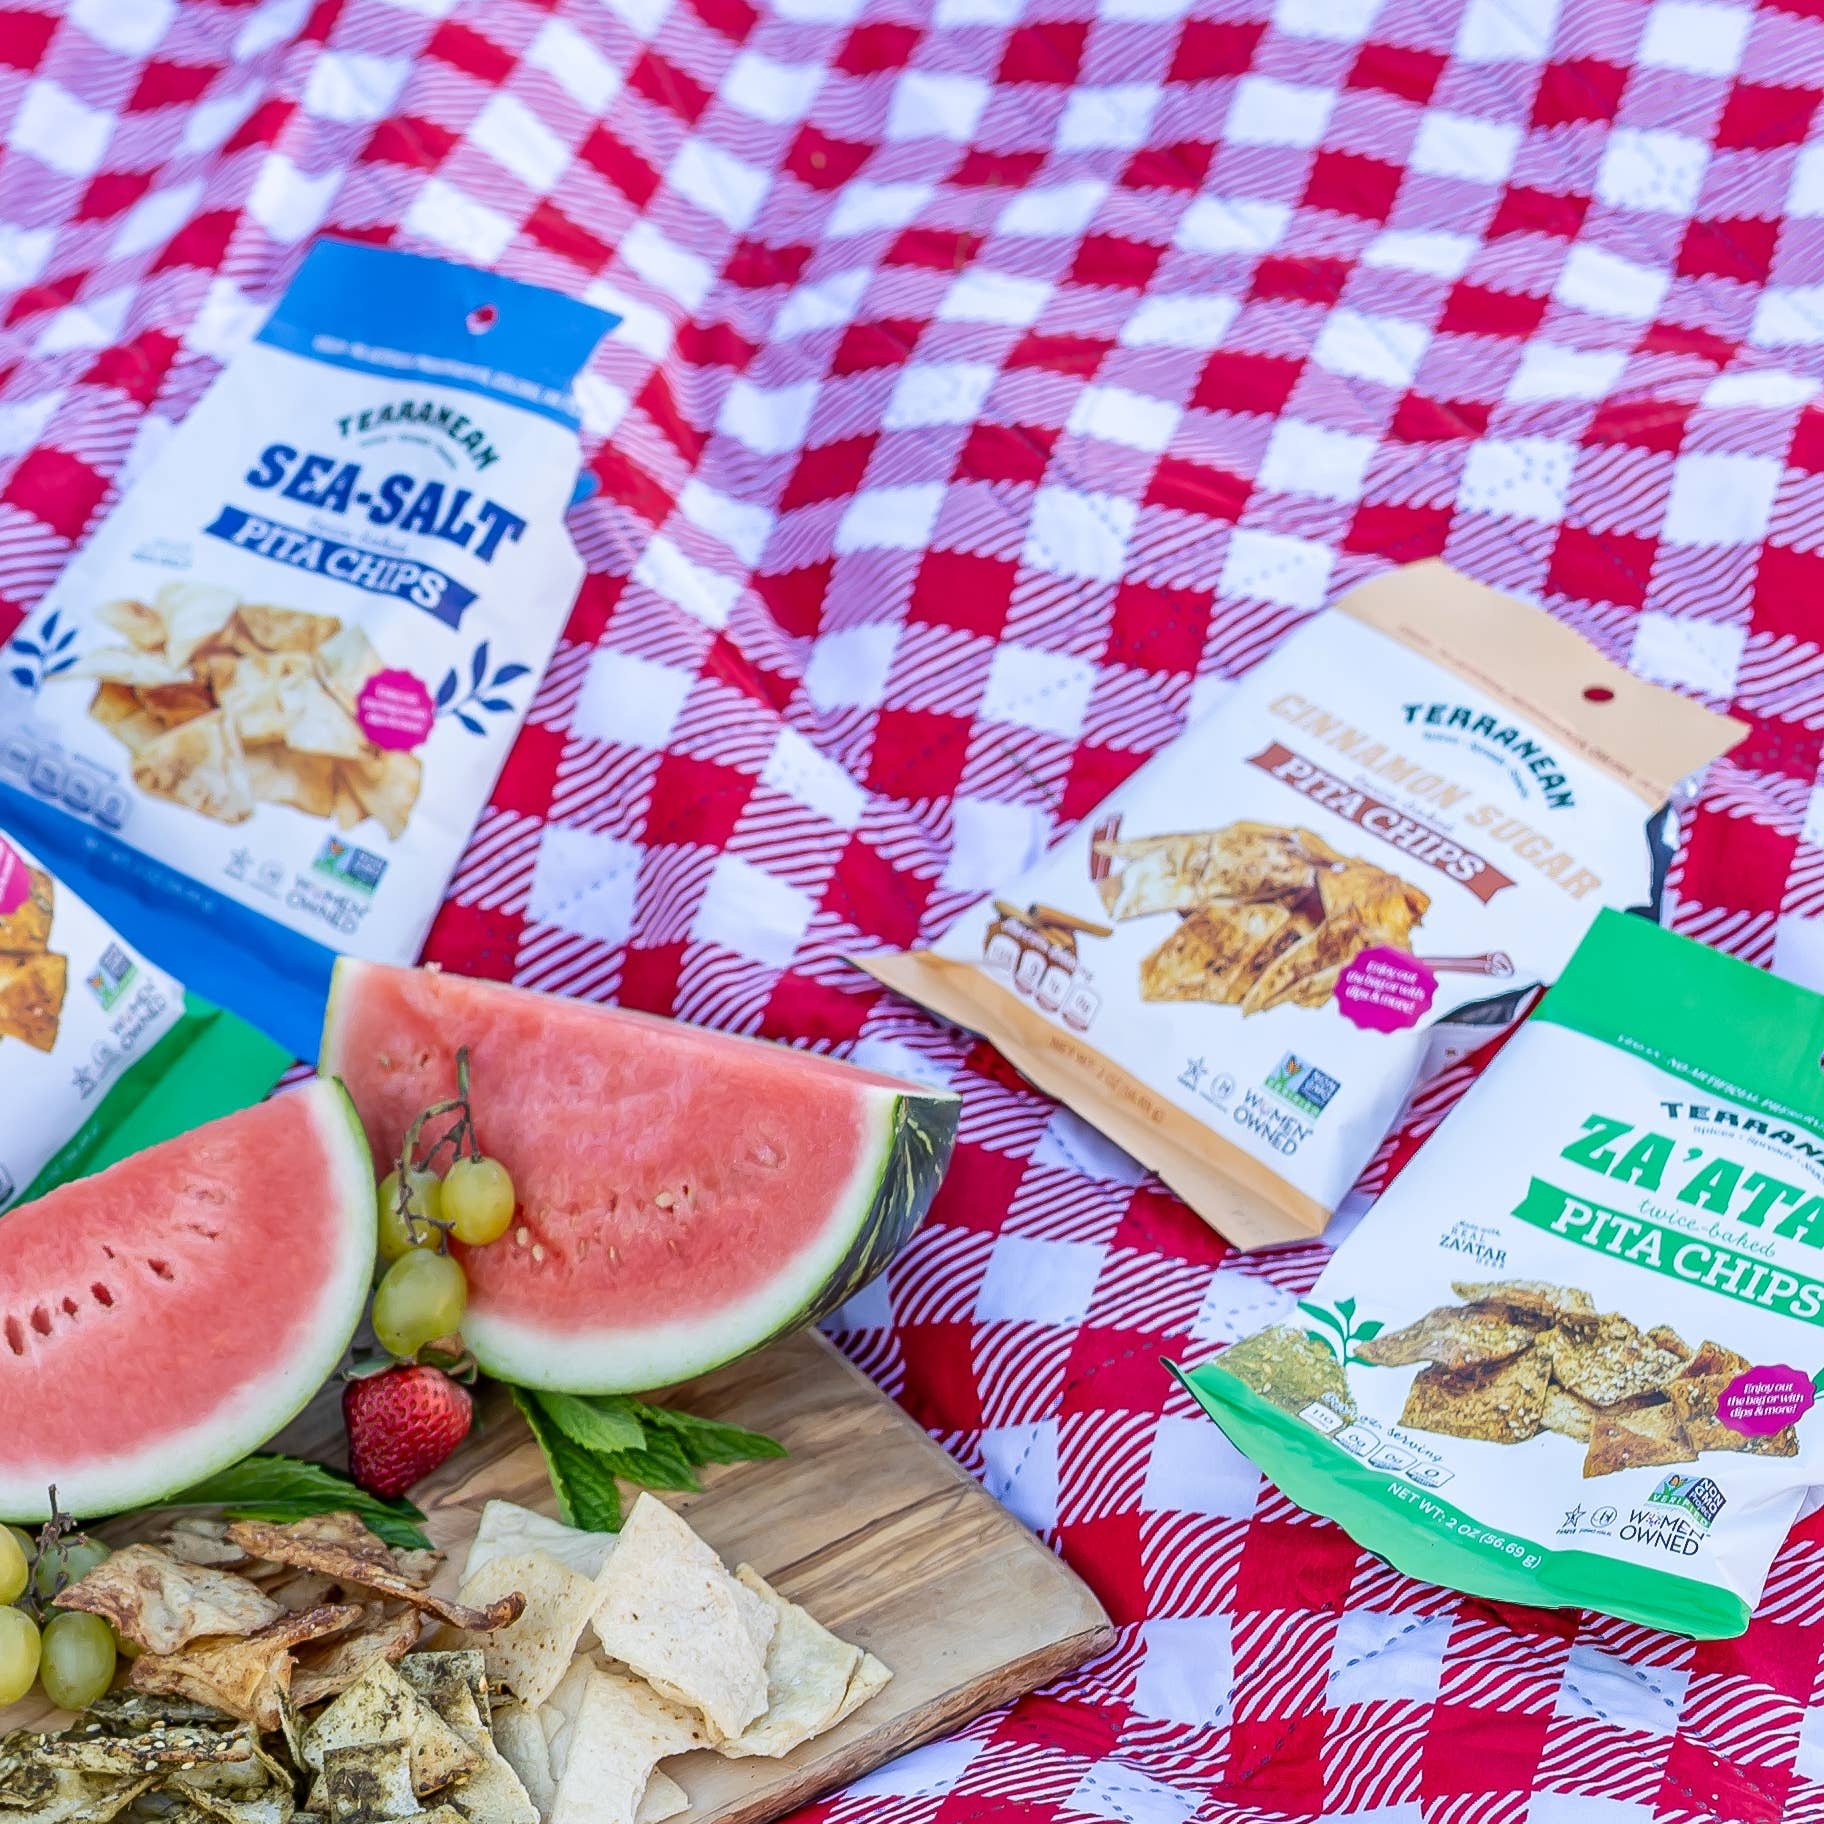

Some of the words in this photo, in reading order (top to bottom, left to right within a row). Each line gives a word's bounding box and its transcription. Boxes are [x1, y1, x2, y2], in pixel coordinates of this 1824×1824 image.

[338, 400, 500, 470] TERRANEAN
[246, 444, 527, 563] SEA-SALT
[233, 518, 325, 569] PITA
[325, 548, 447, 609] CHIPS
[1402, 702, 1576, 811] TERRANEAN
[1267, 691, 1472, 811] CINNAMON
[1465, 803, 1602, 901] SUGAR
[1274, 754, 1367, 820] PITA
[1362, 805, 1486, 882] CHIPS
[1233, 1105, 1297, 1156] OWNED
[1550, 1197, 1664, 1268] PITA
[1673, 1243, 1824, 1318] CHIPS
[1727, 1396, 1745, 1406] the
[1745, 1395, 1766, 1406] bag
[1780, 1393, 1804, 1403] with
[1730, 1407, 1754, 1419] dips
[1764, 1404, 1798, 1416] more!
[1744, 1382, 1775, 1394] Enjoy
[1775, 1383, 1793, 1393] out
[1387, 1482, 1421, 1504] NET
[1419, 1497, 1446, 1523] WT:
[1445, 1517, 1458, 1529] 2
[1457, 1525, 1482, 1539] OZ
[1479, 1532, 1526, 1558] (56.69
[1521, 1554, 1542, 1570] g)
[1694, 1485, 1718, 1514] GMO
[1700, 1478, 1725, 1508] NON
[1619, 1524, 1699, 1556] OWNED
